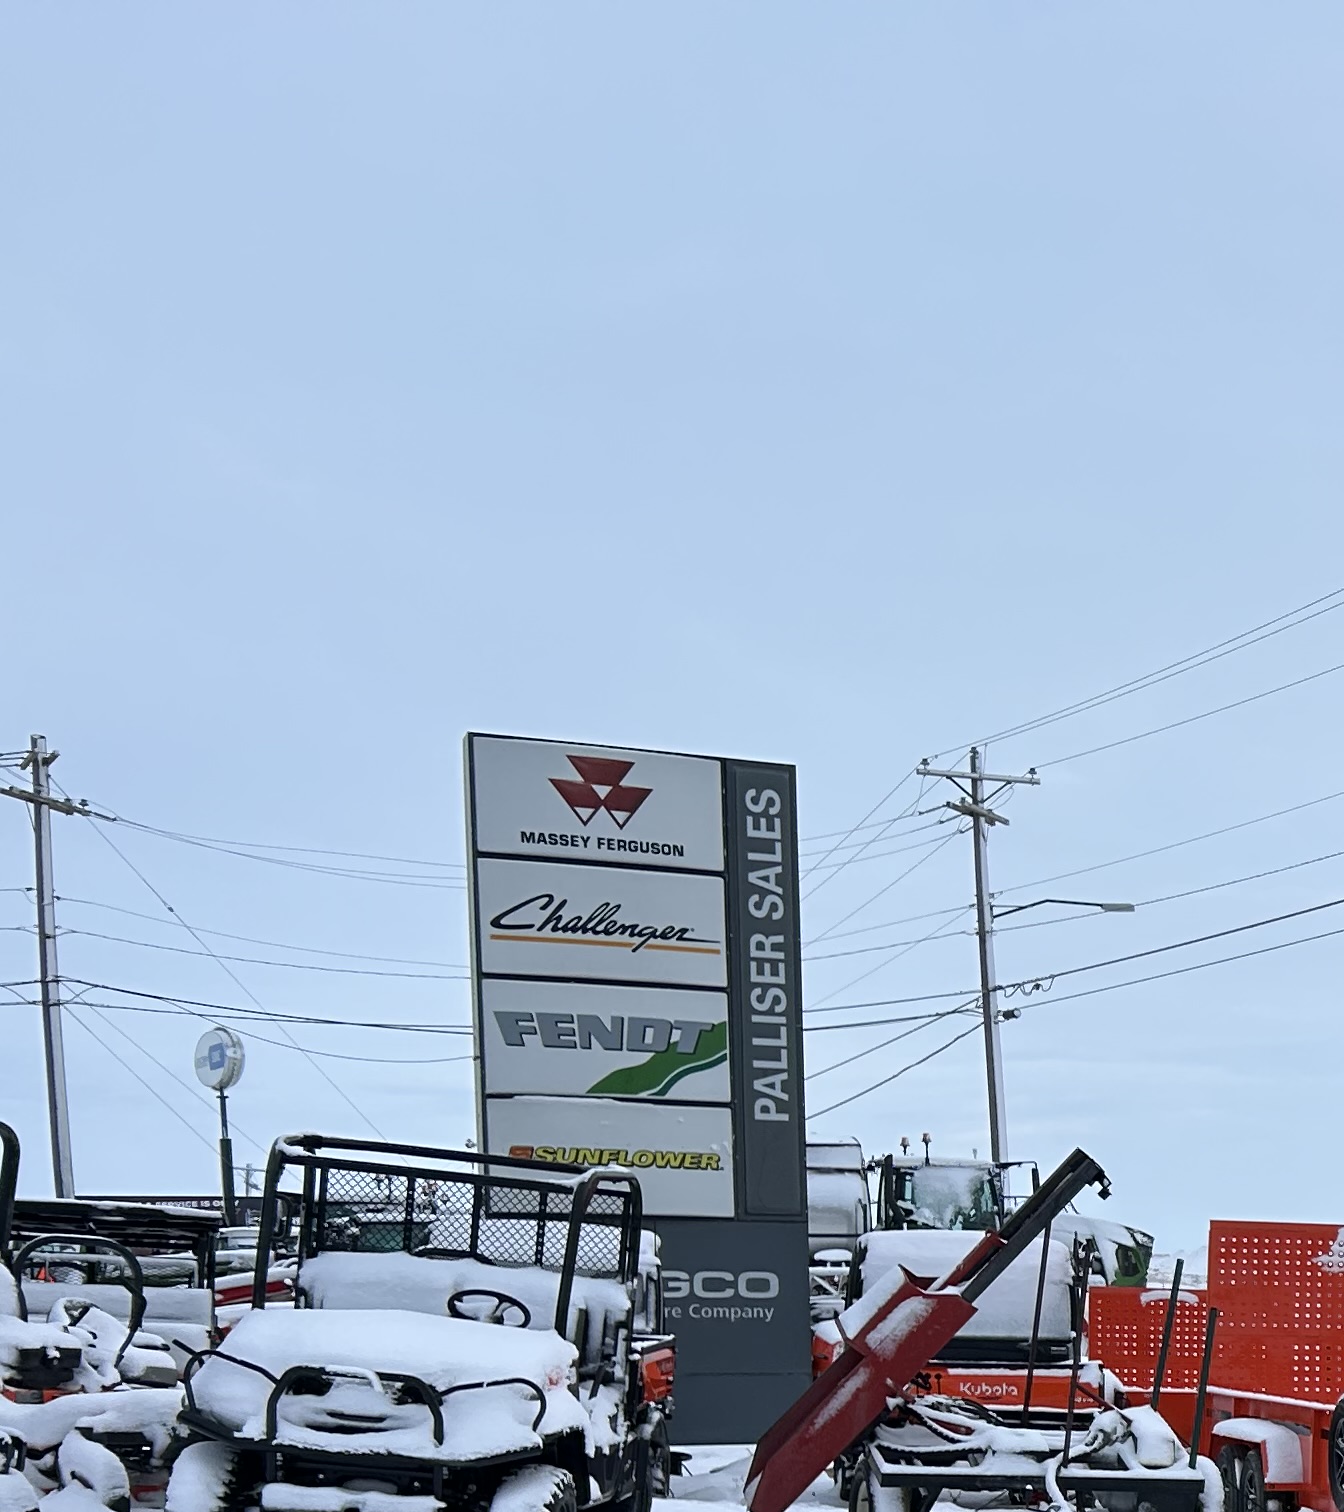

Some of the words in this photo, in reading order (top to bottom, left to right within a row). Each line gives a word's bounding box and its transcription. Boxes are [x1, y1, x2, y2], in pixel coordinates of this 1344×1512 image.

[520, 831, 591, 848] MASSEY
[597, 837, 685, 857] FERGUSON
[745, 788, 784, 920] SALES
[490, 893, 720, 952] Challenger
[493, 1011, 714, 1054] FENDT
[750, 933, 790, 1121] PALLISER
[534, 1146, 721, 1170] SUNFLOWER
[661, 1270, 779, 1298] GCO
[688, 1303, 774, 1322] Company
[959, 1382, 1018, 1396] Kubota
